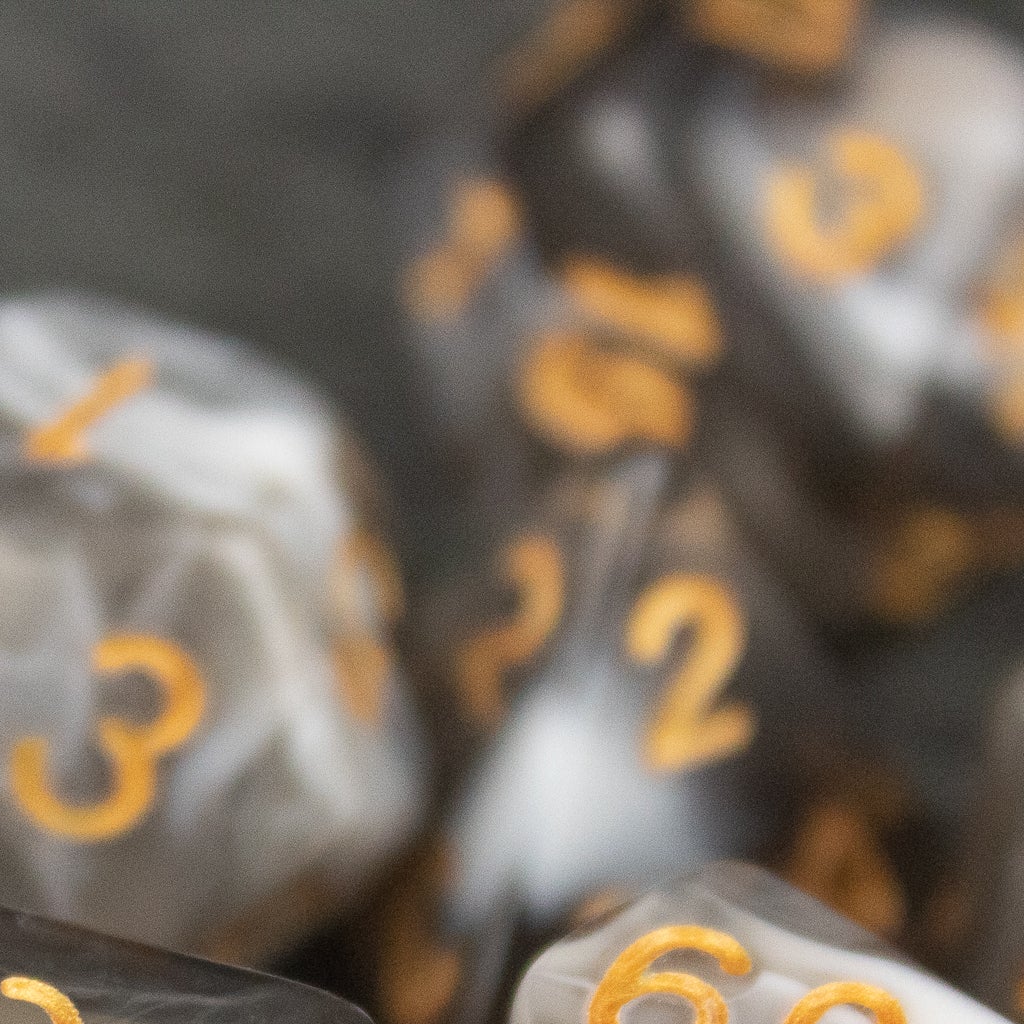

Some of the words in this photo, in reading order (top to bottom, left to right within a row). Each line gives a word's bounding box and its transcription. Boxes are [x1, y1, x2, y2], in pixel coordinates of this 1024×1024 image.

[24, 357, 154, 465] 1
[9, 632, 207, 842] 3
[626, 572, 746, 770] 2
